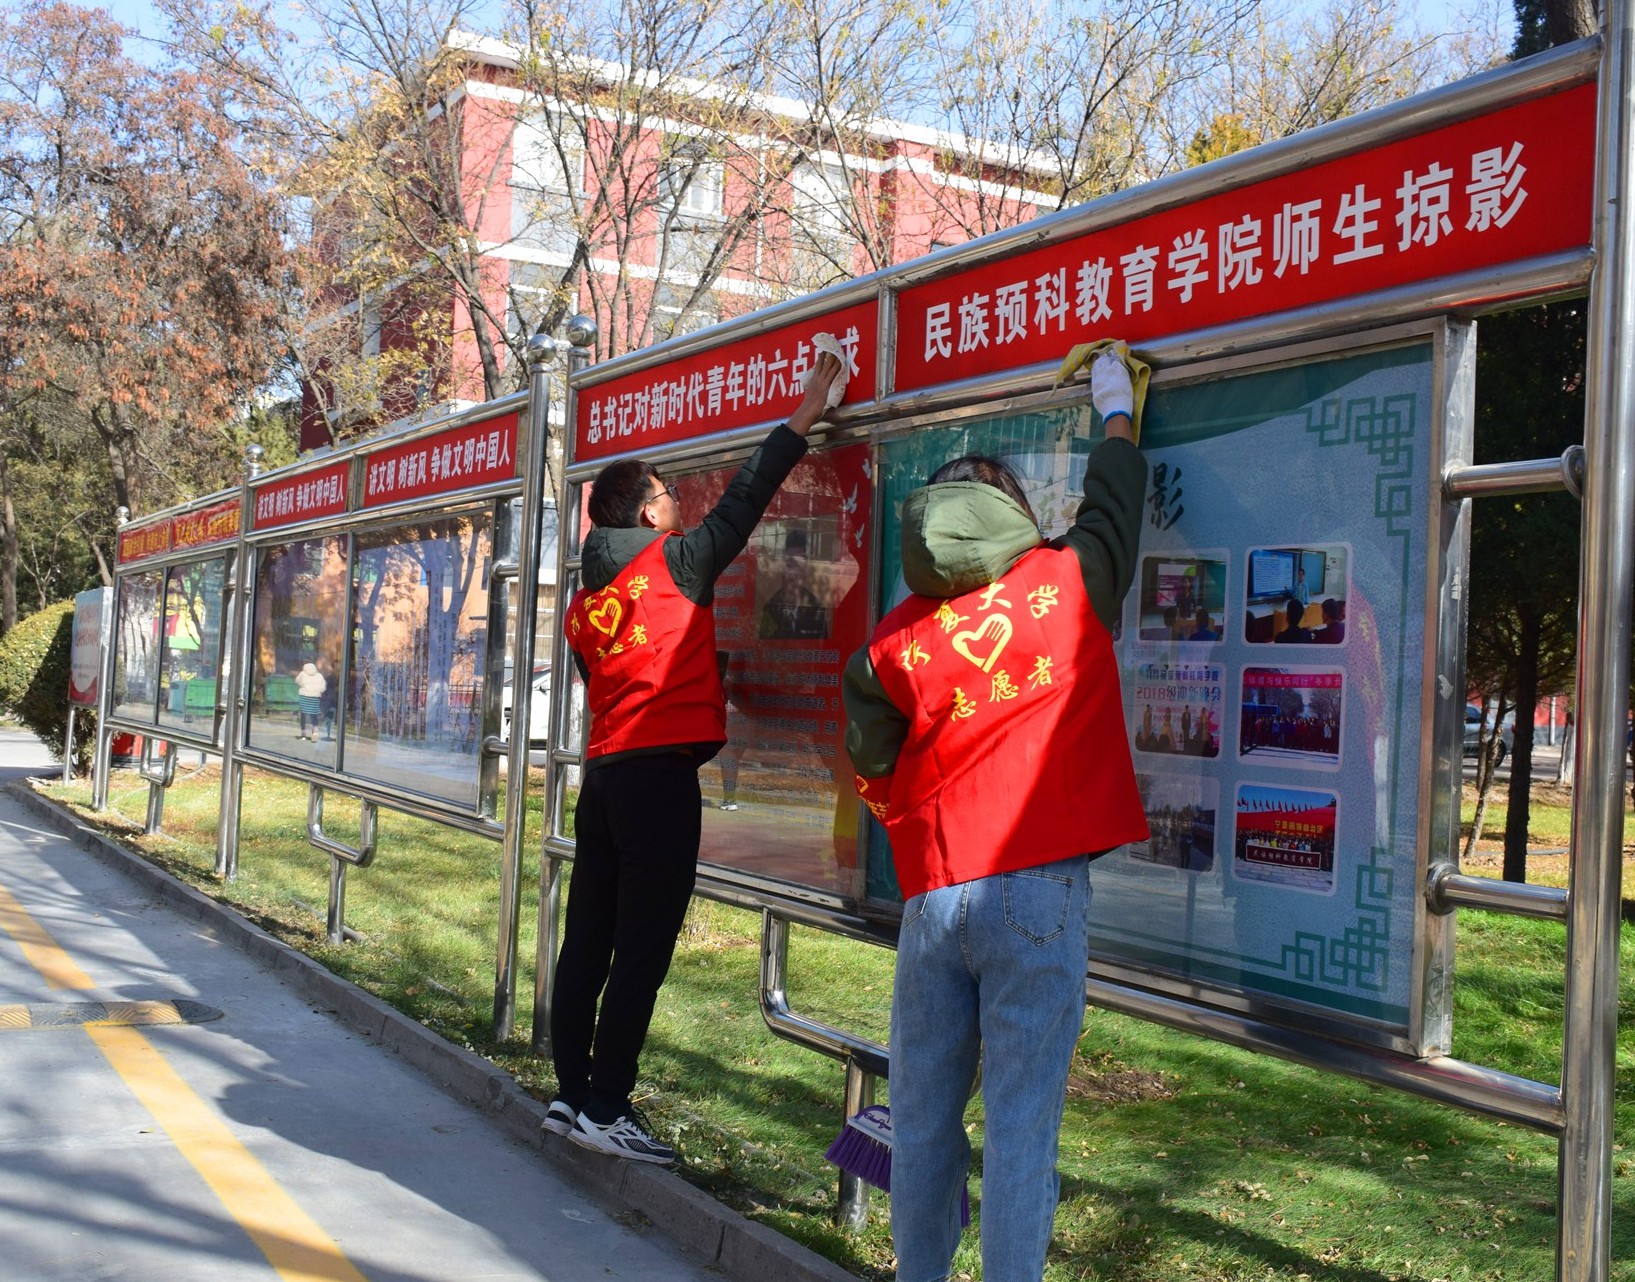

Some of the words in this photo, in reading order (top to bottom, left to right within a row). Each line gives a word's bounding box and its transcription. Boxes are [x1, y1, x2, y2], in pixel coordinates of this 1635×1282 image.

[924, 140, 1529, 363] 民族预科教育学院师生掠影
[587, 325, 860, 443] 总书记对新时代青年的六点求
[368, 459, 396, 496] 讲文明
[398, 451, 427, 489] 树新风
[431, 429, 511, 483] 争做文明中国人
[951, 655, 1054, 722] 志愿者
